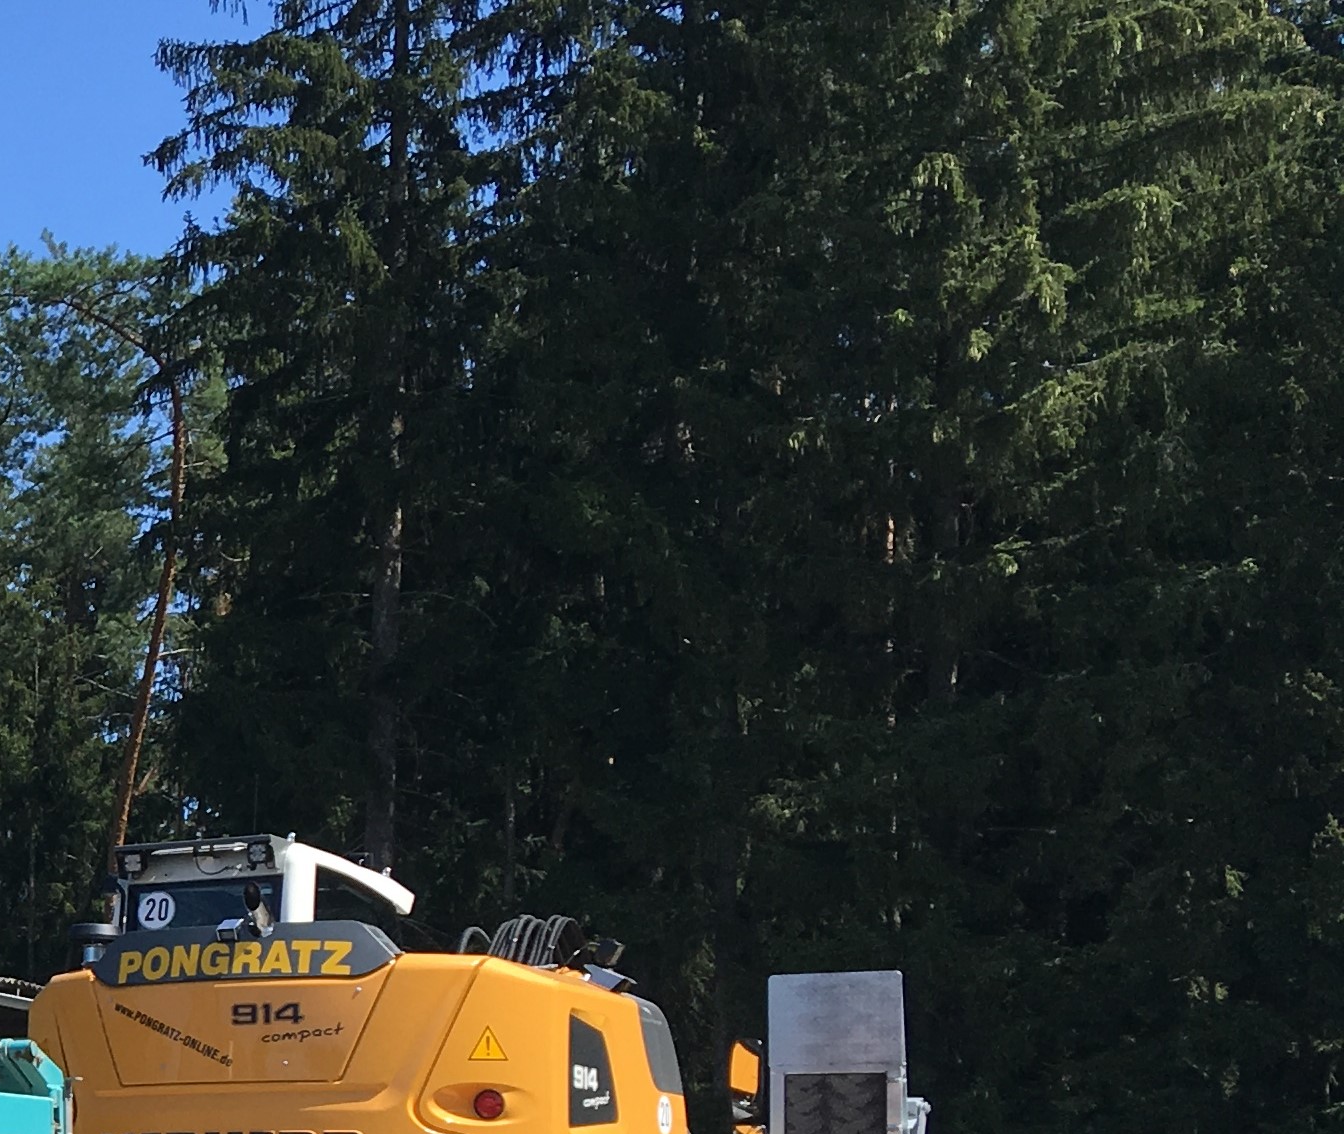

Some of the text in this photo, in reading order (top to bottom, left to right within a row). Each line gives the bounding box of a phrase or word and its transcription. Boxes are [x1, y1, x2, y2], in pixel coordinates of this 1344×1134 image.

[144, 898, 169, 922] 20
[118, 940, 353, 984] PONGRATZ
[231, 1003, 303, 1025] 914
[114, 1003, 233, 1068] www.PONGRATZ-ONLINE.de
[261, 1023, 344, 1043] compact
[573, 1064, 599, 1092] 914
[660, 1102, 670, 1127] 20
